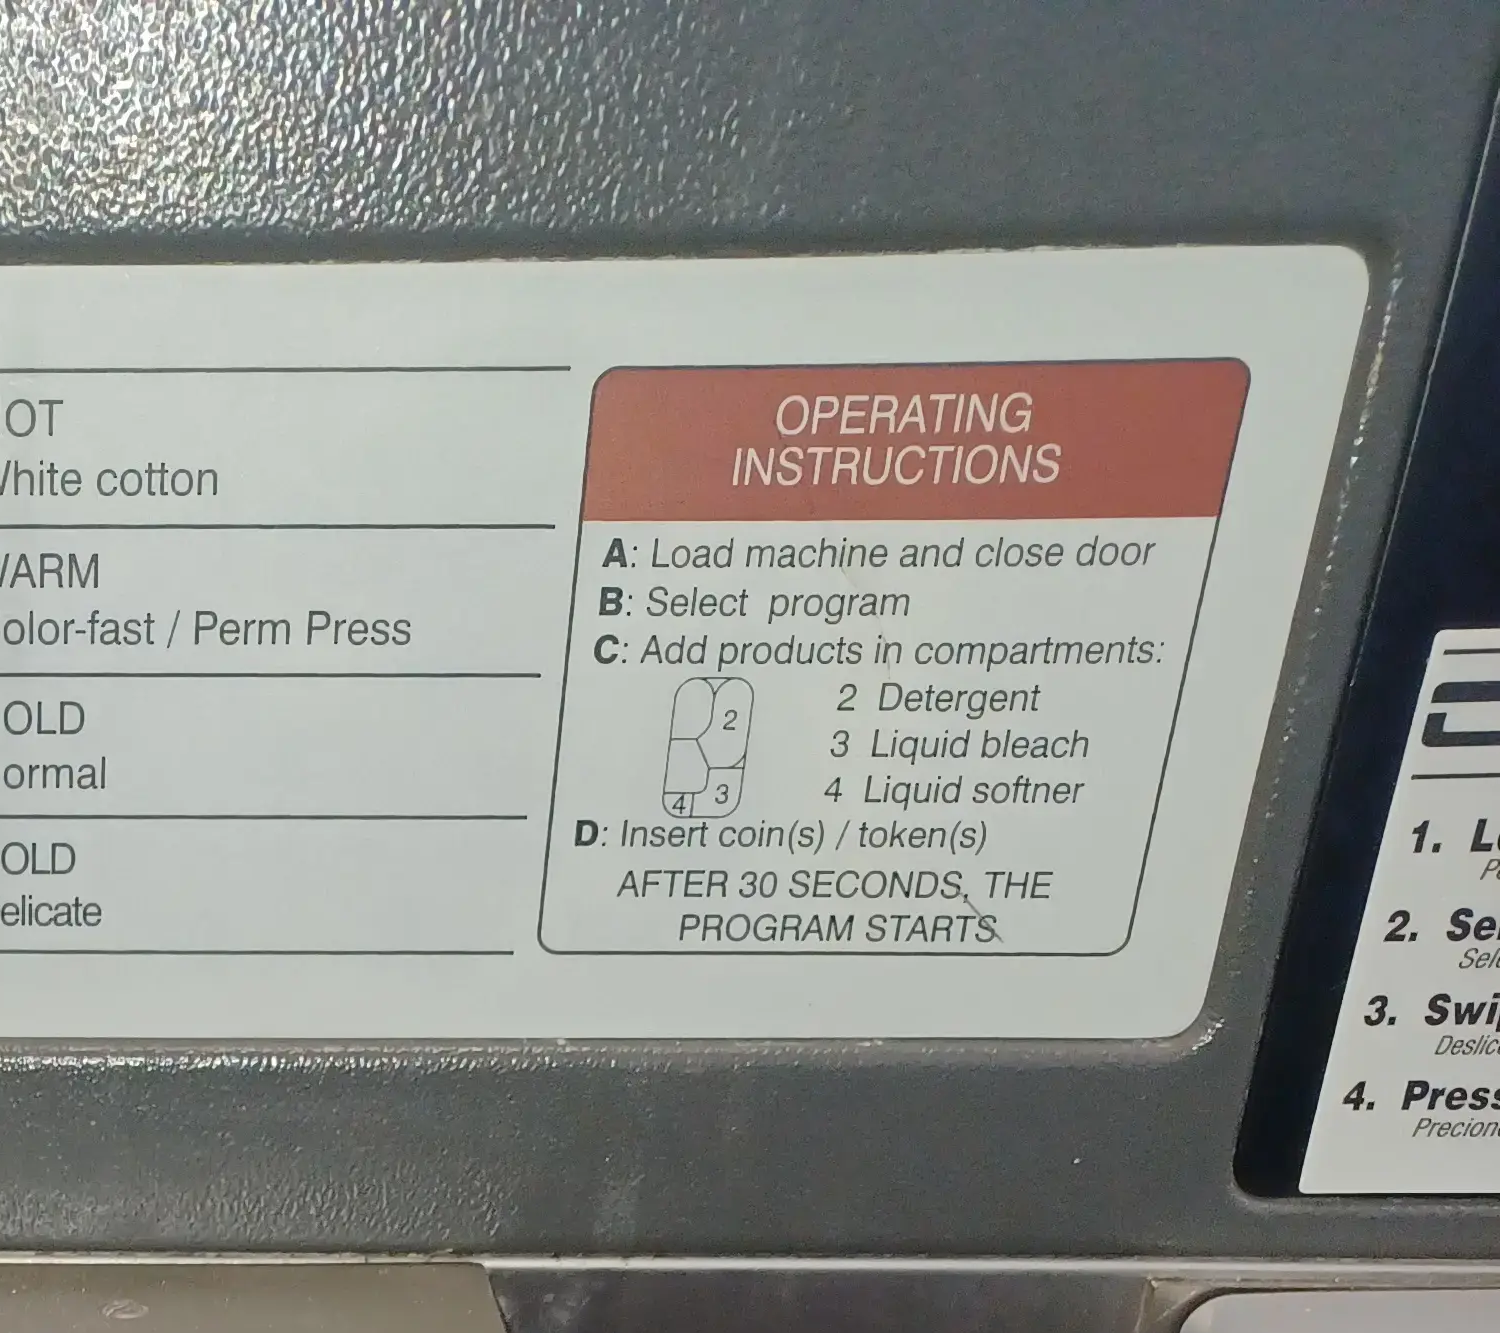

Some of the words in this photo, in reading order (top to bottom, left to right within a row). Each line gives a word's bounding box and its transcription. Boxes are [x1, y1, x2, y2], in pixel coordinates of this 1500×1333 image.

[776, 392, 1033, 435] OPERATING
[96, 462, 218, 497] cotton
[732, 443, 1062, 486] INSTRUCTIONS
[601, 537, 638, 568] A:
[651, 537, 734, 569] Load
[745, 536, 888, 569] machine
[899, 536, 965, 568] and
[975, 536, 1064, 568] close
[1076, 535, 1157, 567] door
[598, 586, 633, 617] B:
[646, 586, 749, 617] Select
[767, 593, 910, 625] program
[166, 609, 181, 649] /
[194, 610, 291, 646] Perm
[306, 610, 411, 646] Press
[593, 634, 629, 665] C:
[639, 634, 708, 665] Add
[717, 634, 863, 673] products
[874, 634, 902, 664] in
[914, 636, 1165, 673] compartments:
[836, 683, 858, 712] 2
[878, 682, 1041, 720] Detergent
[722, 709, 738, 731] 2
[830, 729, 850, 758] 3
[871, 728, 971, 766] Liquid
[980, 729, 1089, 759] bleach
[670, 794, 686, 815] 4
[714, 783, 729, 805] 3
[823, 776, 843, 803] 4
[864, 774, 963, 811] Liquid
[972, 774, 1085, 804] softner
[574, 819, 608, 847] D:
[621, 820, 709, 848] Insert
[718, 819, 825, 855] coin(s)
[835, 819, 851, 851] /
[858, 820, 987, 856] token(s)
[1411, 819, 1442, 854] 1.
[1470, 818, 1500, 853] L
[616, 869, 729, 898] AFTER
[738, 870, 778, 899] 30
[788, 870, 970, 904] SECONDS,
[985, 871, 1054, 899] THE
[1479, 858, 1500, 881] P
[679, 913, 855, 942] PROGRAM
[865, 914, 998, 943] STARTS
[1383, 909, 1418, 942] 2.
[1446, 907, 1500, 942] Se
[1458, 947, 1500, 969] Sel
[1363, 995, 1397, 1027] 3.
[1424, 992, 1500, 1033] Swi
[1434, 1034, 1500, 1056] Deslic
[1342, 1080, 1375, 1111] 4.
[1412, 1117, 1500, 1138] Precion
